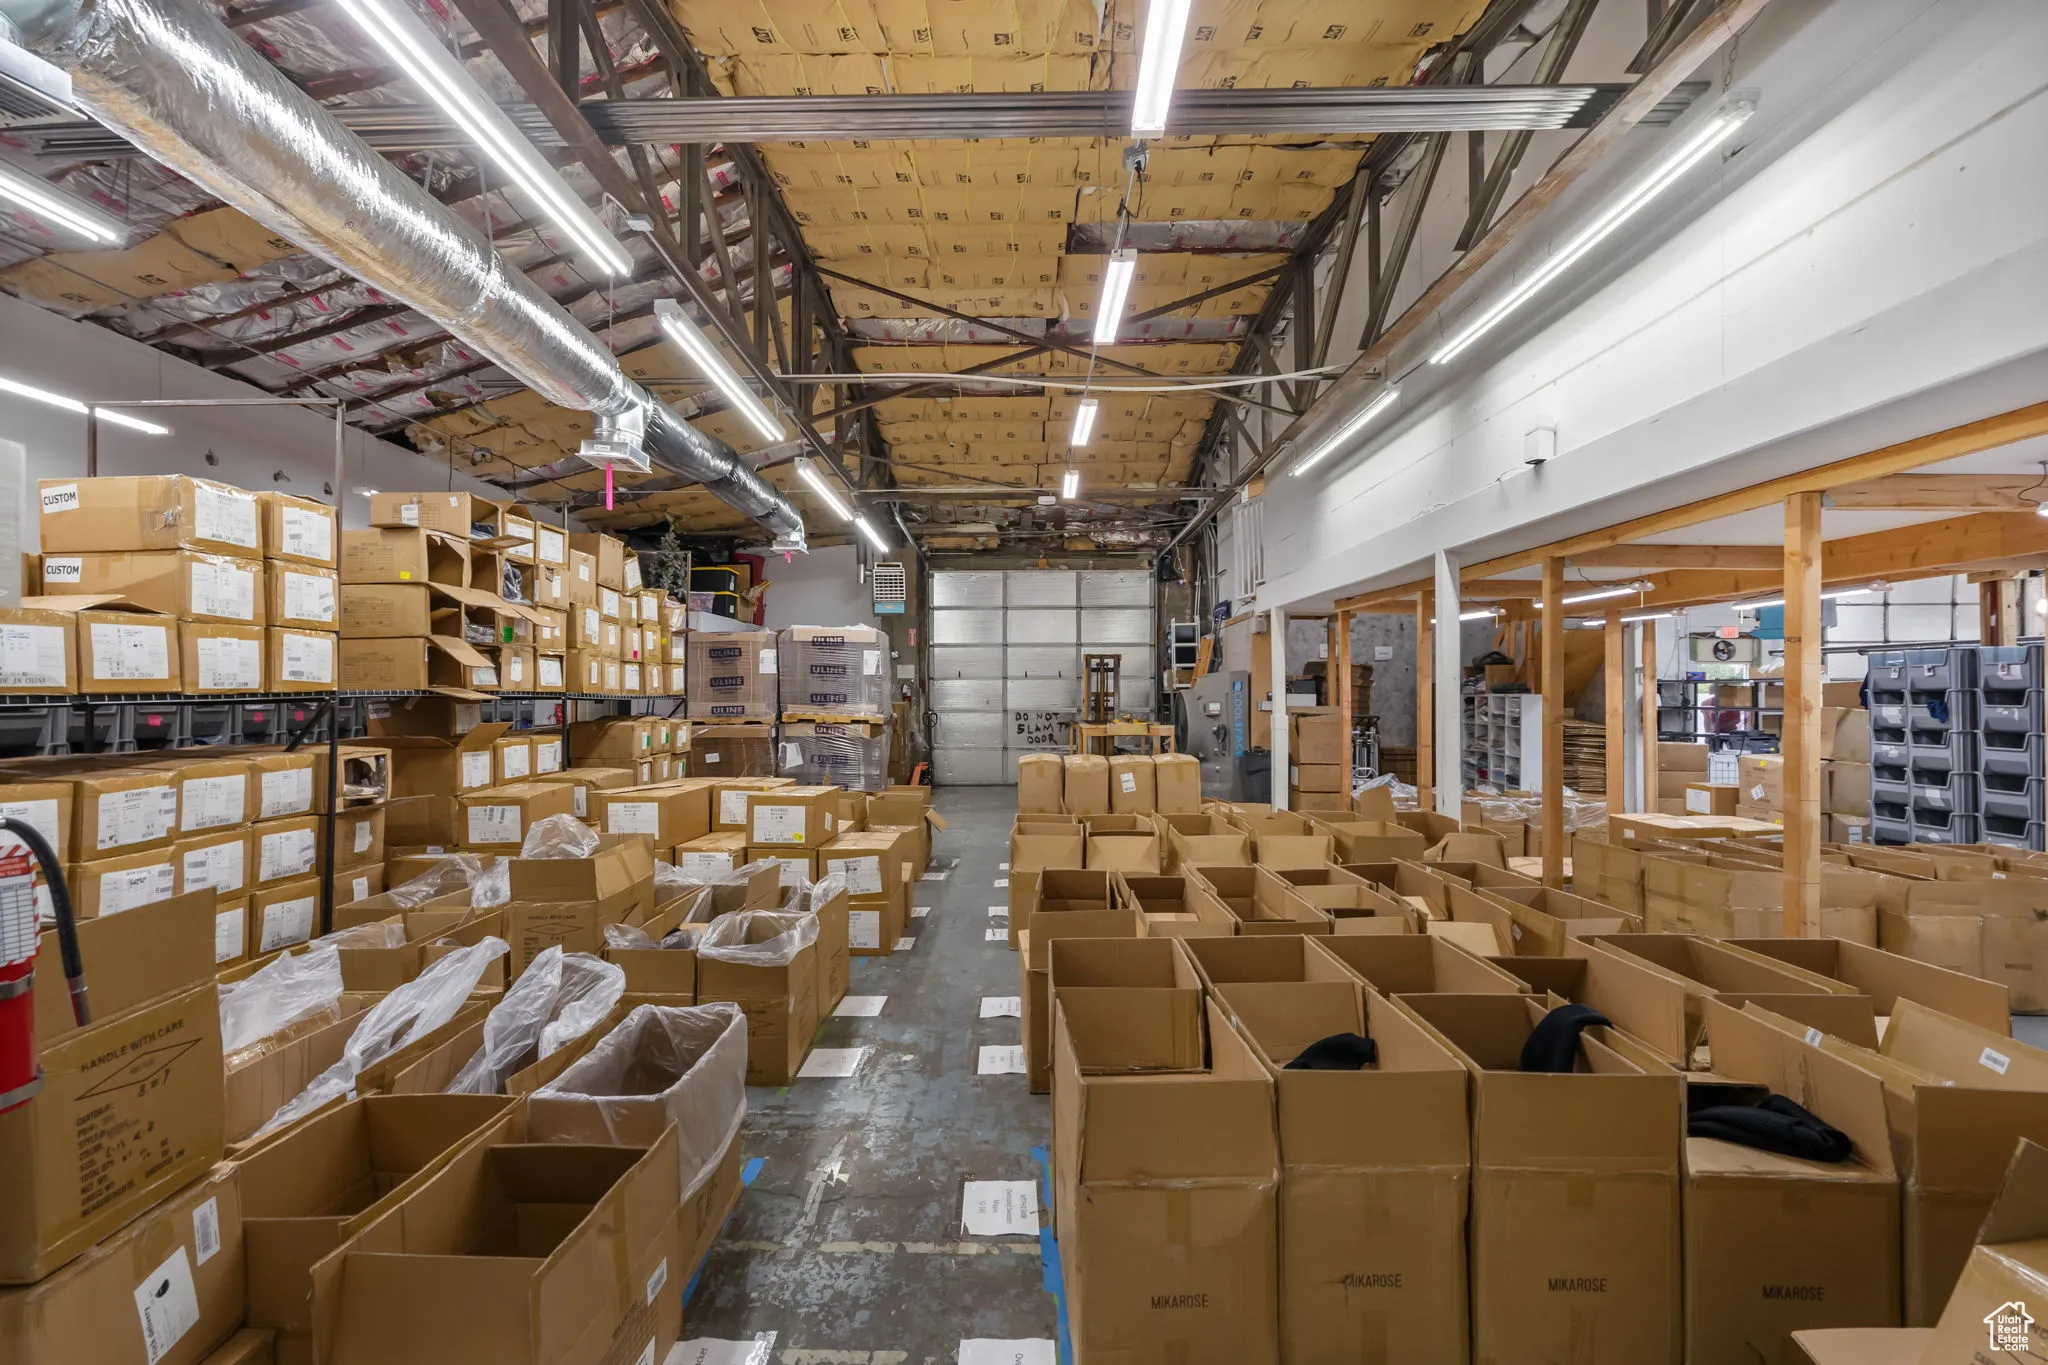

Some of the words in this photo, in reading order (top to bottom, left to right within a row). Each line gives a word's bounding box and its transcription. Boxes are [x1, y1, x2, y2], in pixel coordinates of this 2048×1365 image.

[43, 491, 76, 506] CUSTOM
[46, 565, 79, 575] CUSTOM
[710, 648, 741, 657] ULINE
[711, 677, 743, 686] ULINE
[812, 694, 845, 702] ULINE
[712, 706, 744, 714] ULINE
[1015, 712, 1029, 721] DO
[1036, 712, 1060, 721] NOT
[1016, 722, 1054, 734] SLAM
[1027, 733, 1058, 745] DOOR
[81, 1045, 127, 1074] HANDLE
[129, 1032, 157, 1052] WITH
[158, 1018, 185, 1038] CARE
[1346, 1273, 1402, 1289] MIKAROSE
[1548, 1278, 1608, 1293] MIKAROSE
[1762, 1285, 1825, 1301] MIKAROSE
[1151, 1294, 1209, 1309] MIKAROSE
[143, 1306, 155, 1338] delivery
[149, 1338, 159, 1362] Truck
